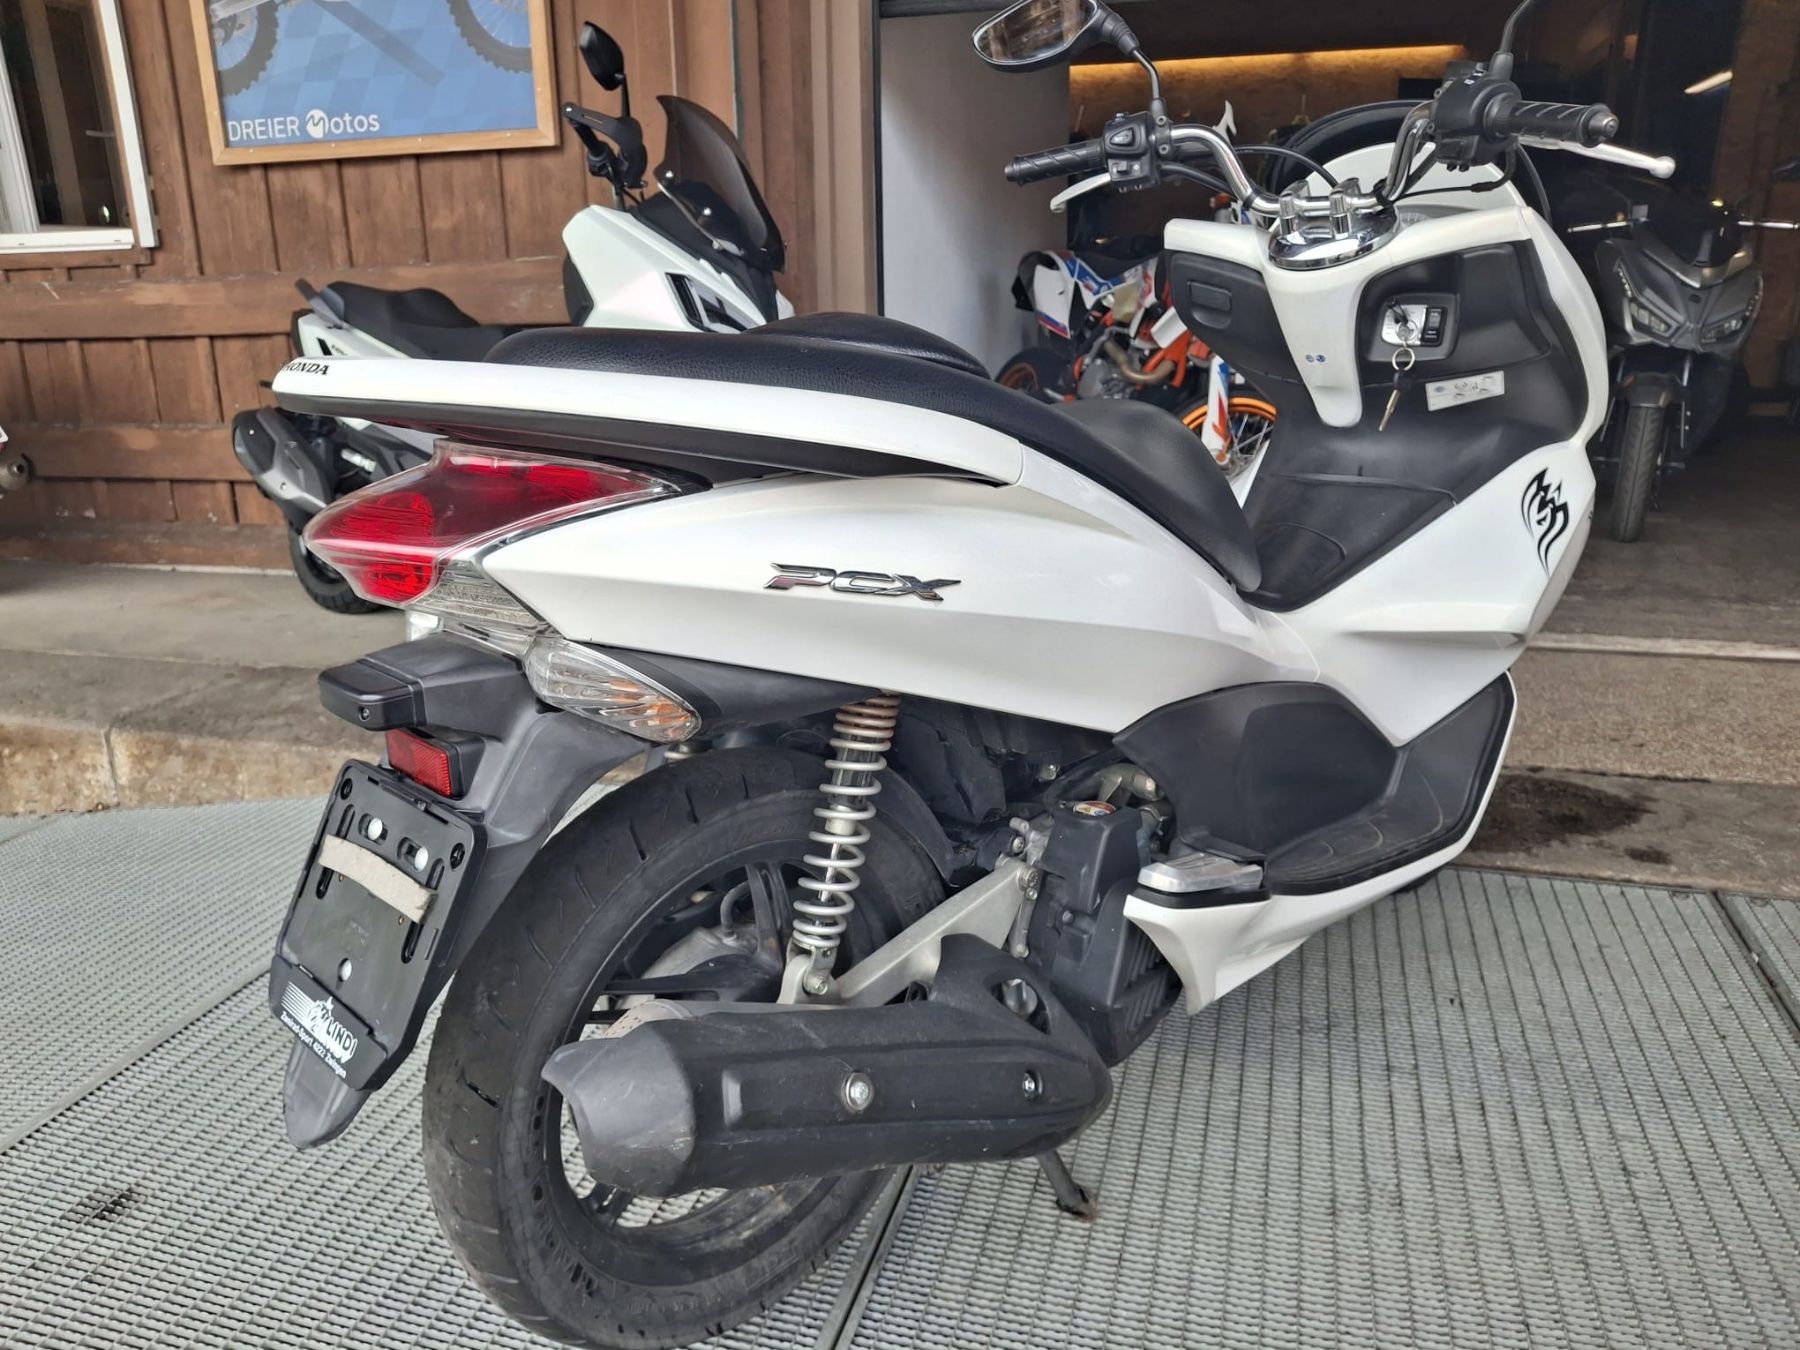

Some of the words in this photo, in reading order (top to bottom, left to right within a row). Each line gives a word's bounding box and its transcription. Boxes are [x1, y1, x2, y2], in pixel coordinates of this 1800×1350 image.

[227, 116, 301, 142] DREIER
[306, 108, 380, 139] Motos
[764, 562, 962, 602] PCX
[325, 1015, 358, 1060] LINDI
